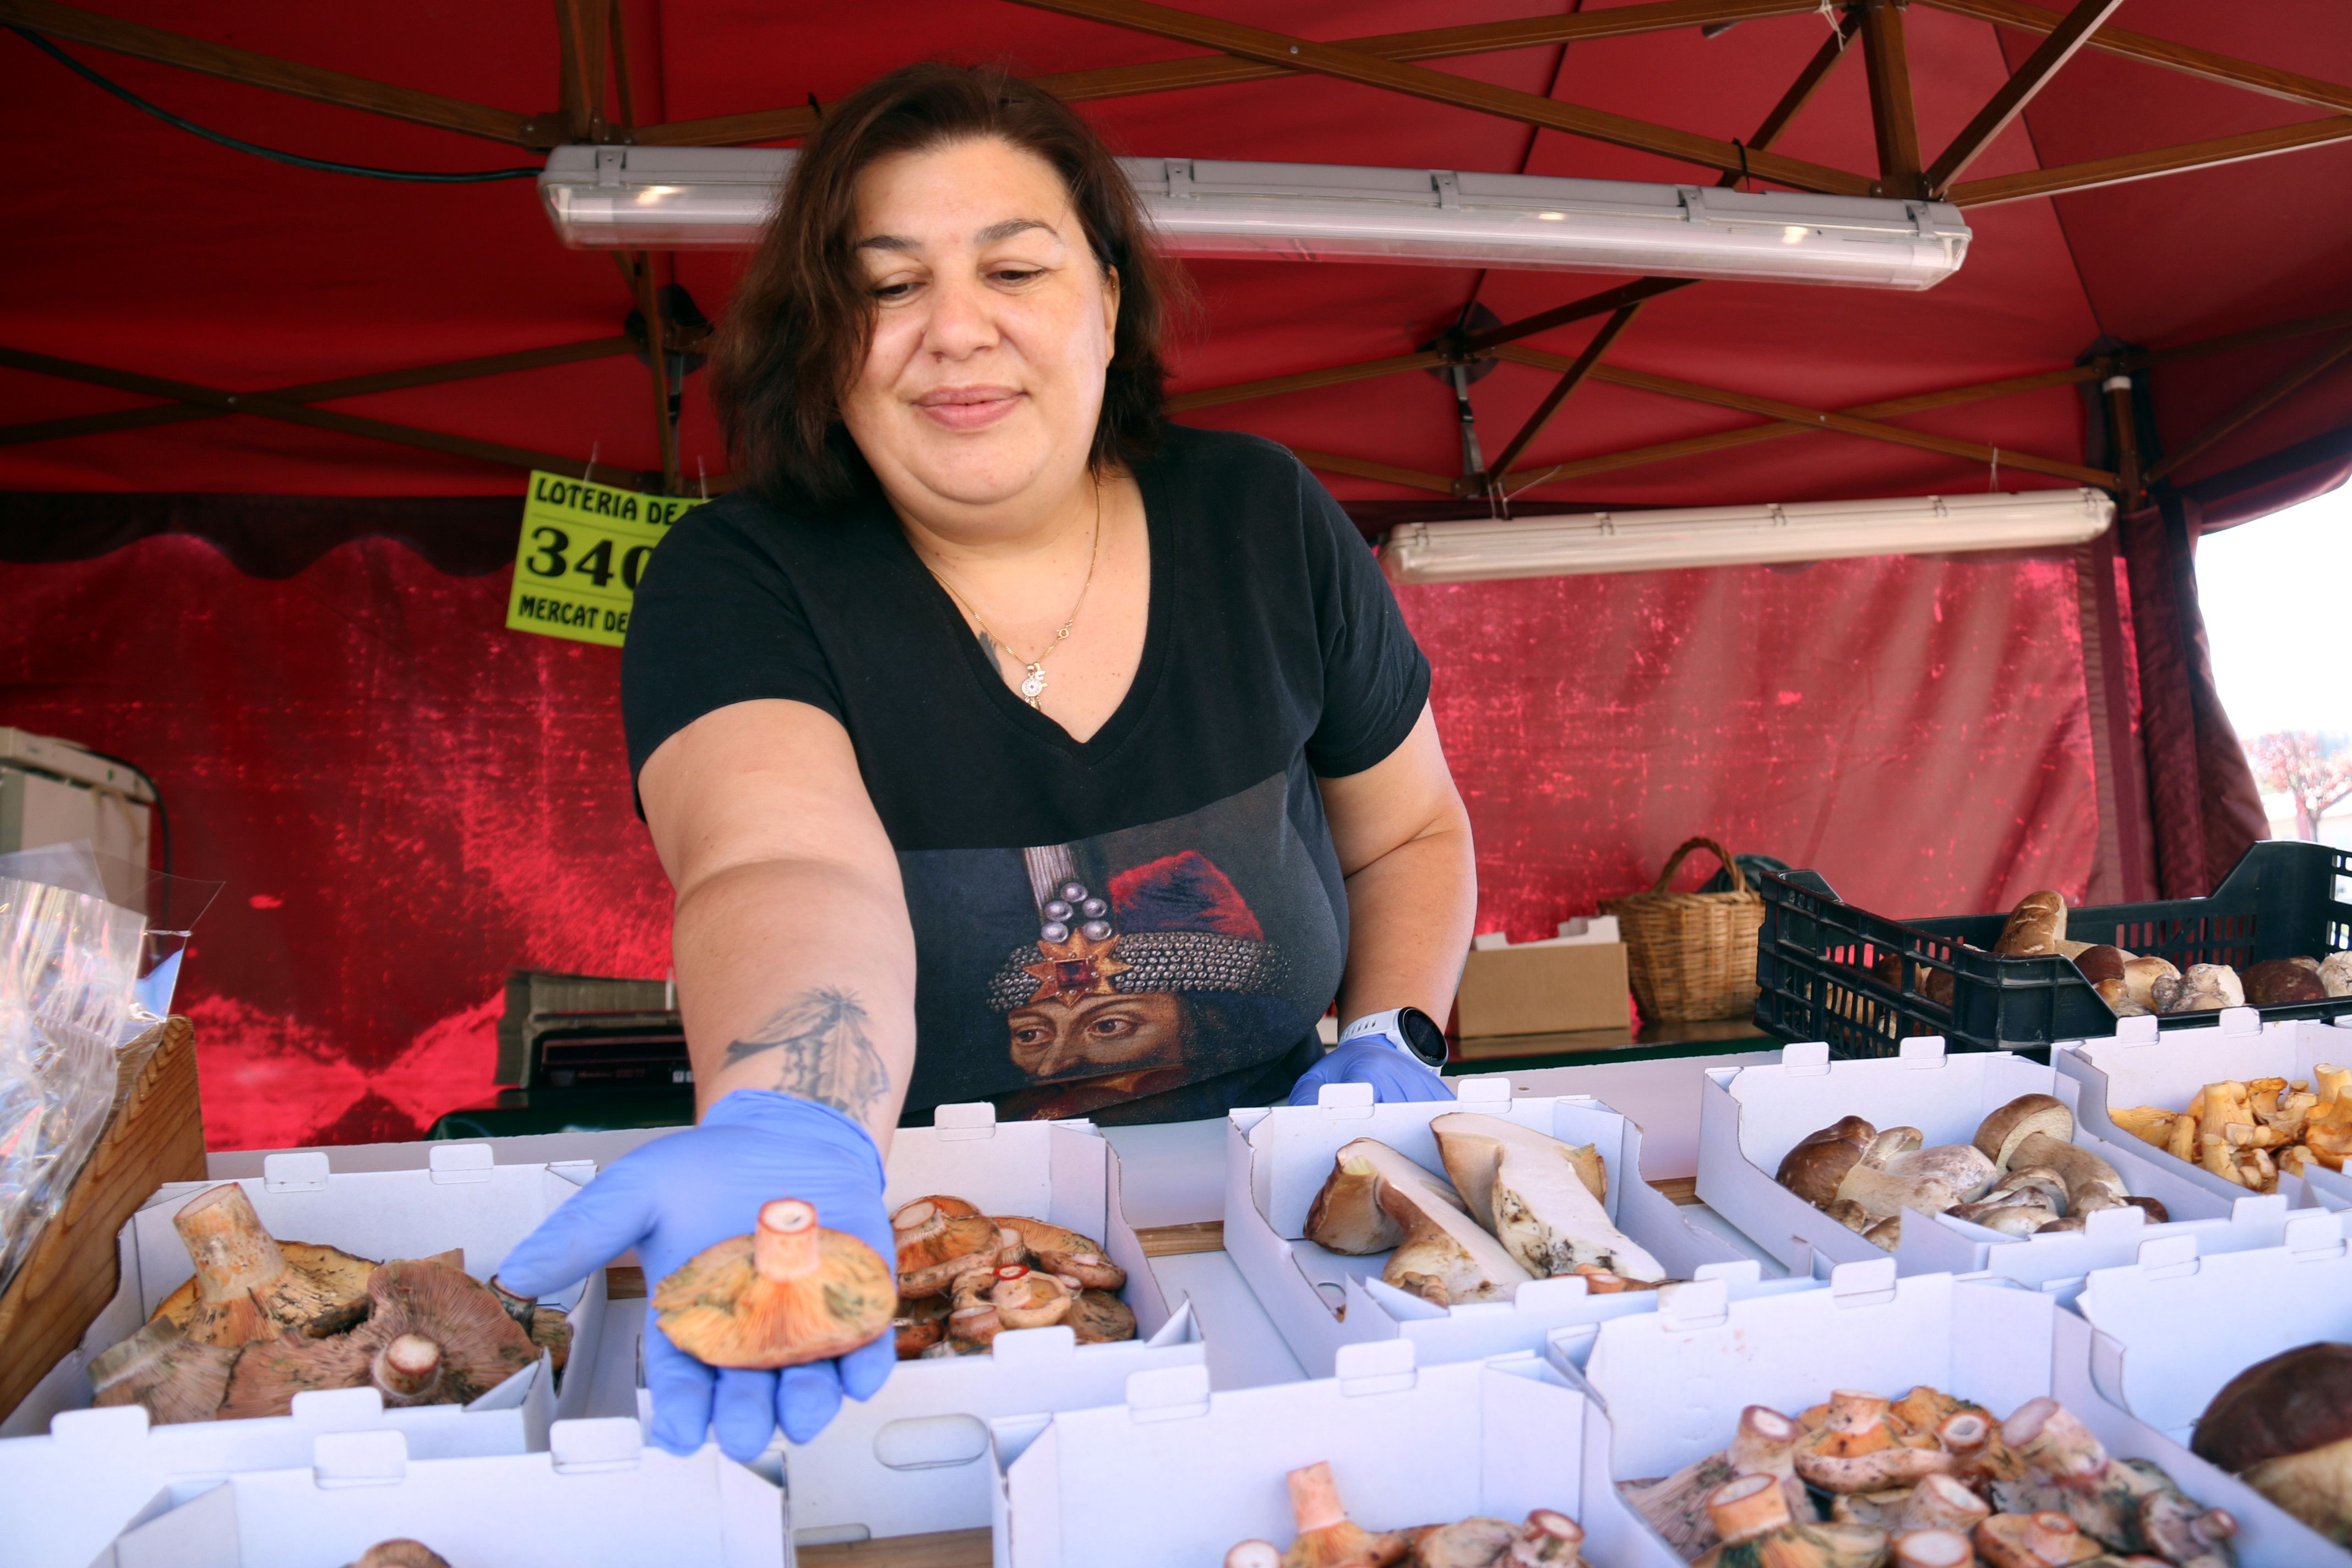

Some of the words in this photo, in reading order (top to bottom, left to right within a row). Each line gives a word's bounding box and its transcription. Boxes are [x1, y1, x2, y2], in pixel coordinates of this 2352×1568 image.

[535, 478, 636, 520] LOTERIA
[647, 502, 678, 525] DE
[519, 595, 598, 628] MERCAT
